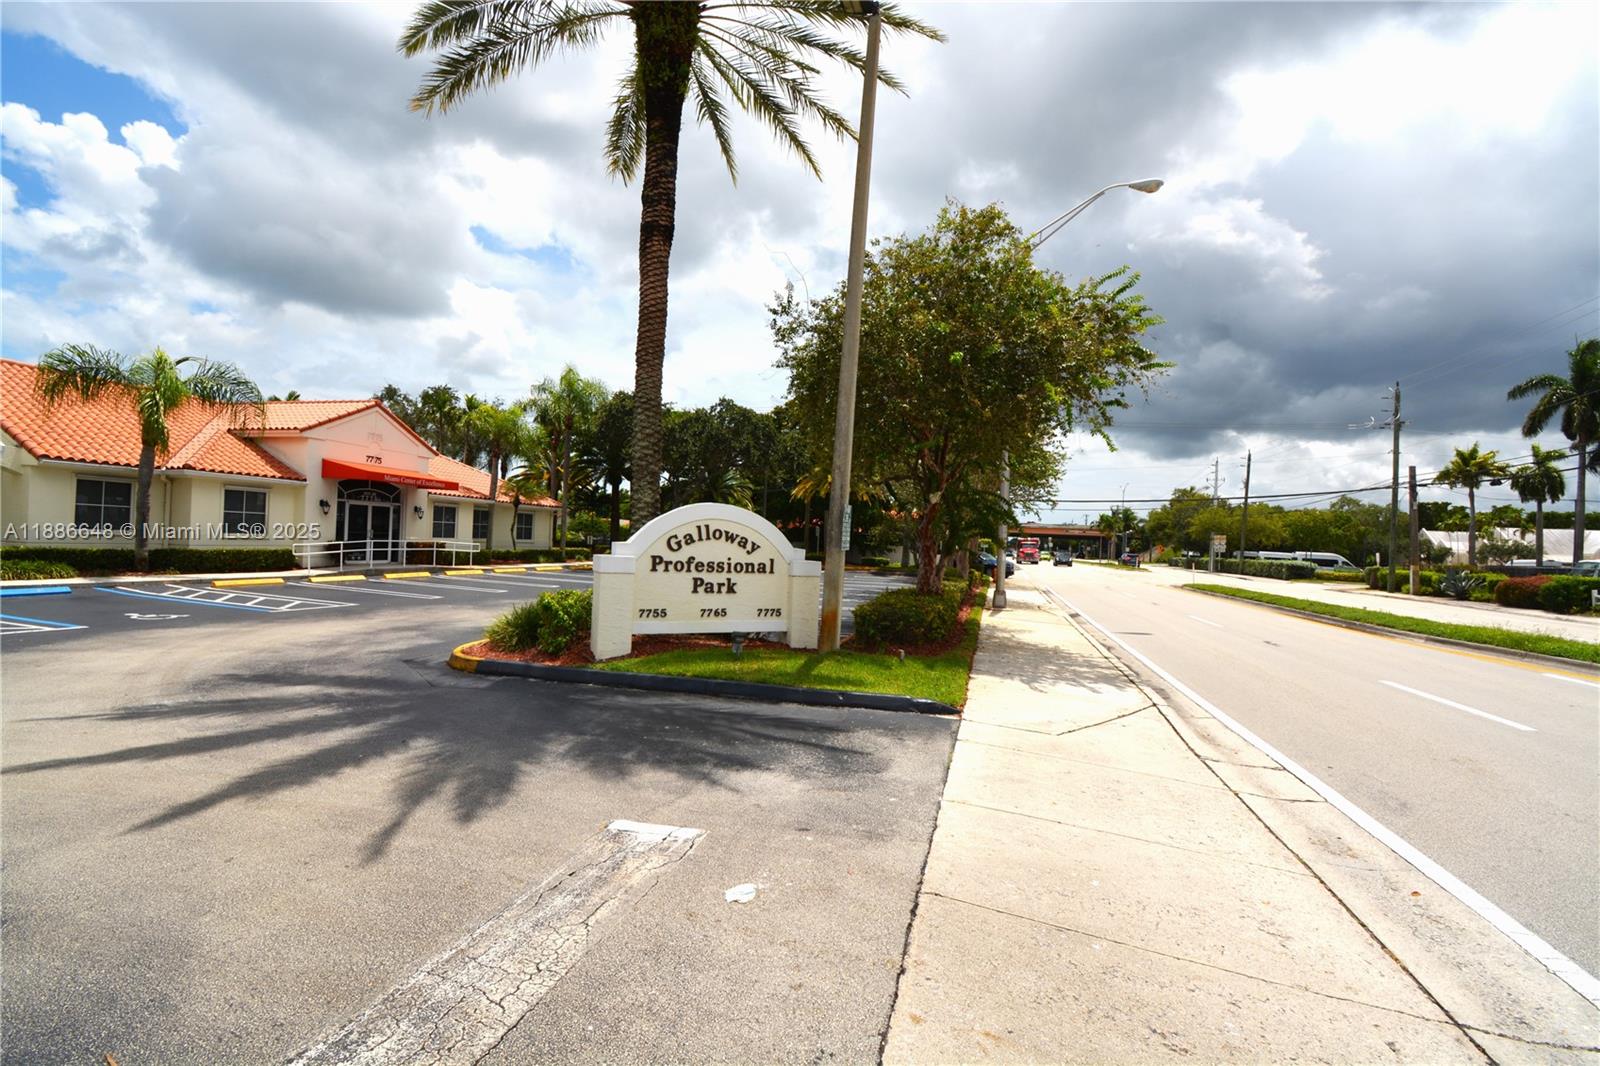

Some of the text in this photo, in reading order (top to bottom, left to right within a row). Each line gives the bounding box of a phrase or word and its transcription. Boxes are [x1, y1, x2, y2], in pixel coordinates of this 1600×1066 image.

[366, 455, 382, 464] 7775
[384, 474, 400, 482] Miami
[400, 477, 417, 485] Center
[666, 524, 761, 555] Galloway
[650, 555, 775, 574] Professional
[691, 577, 737, 594] Park
[638, 608, 782, 618] 7755 7765 7775
